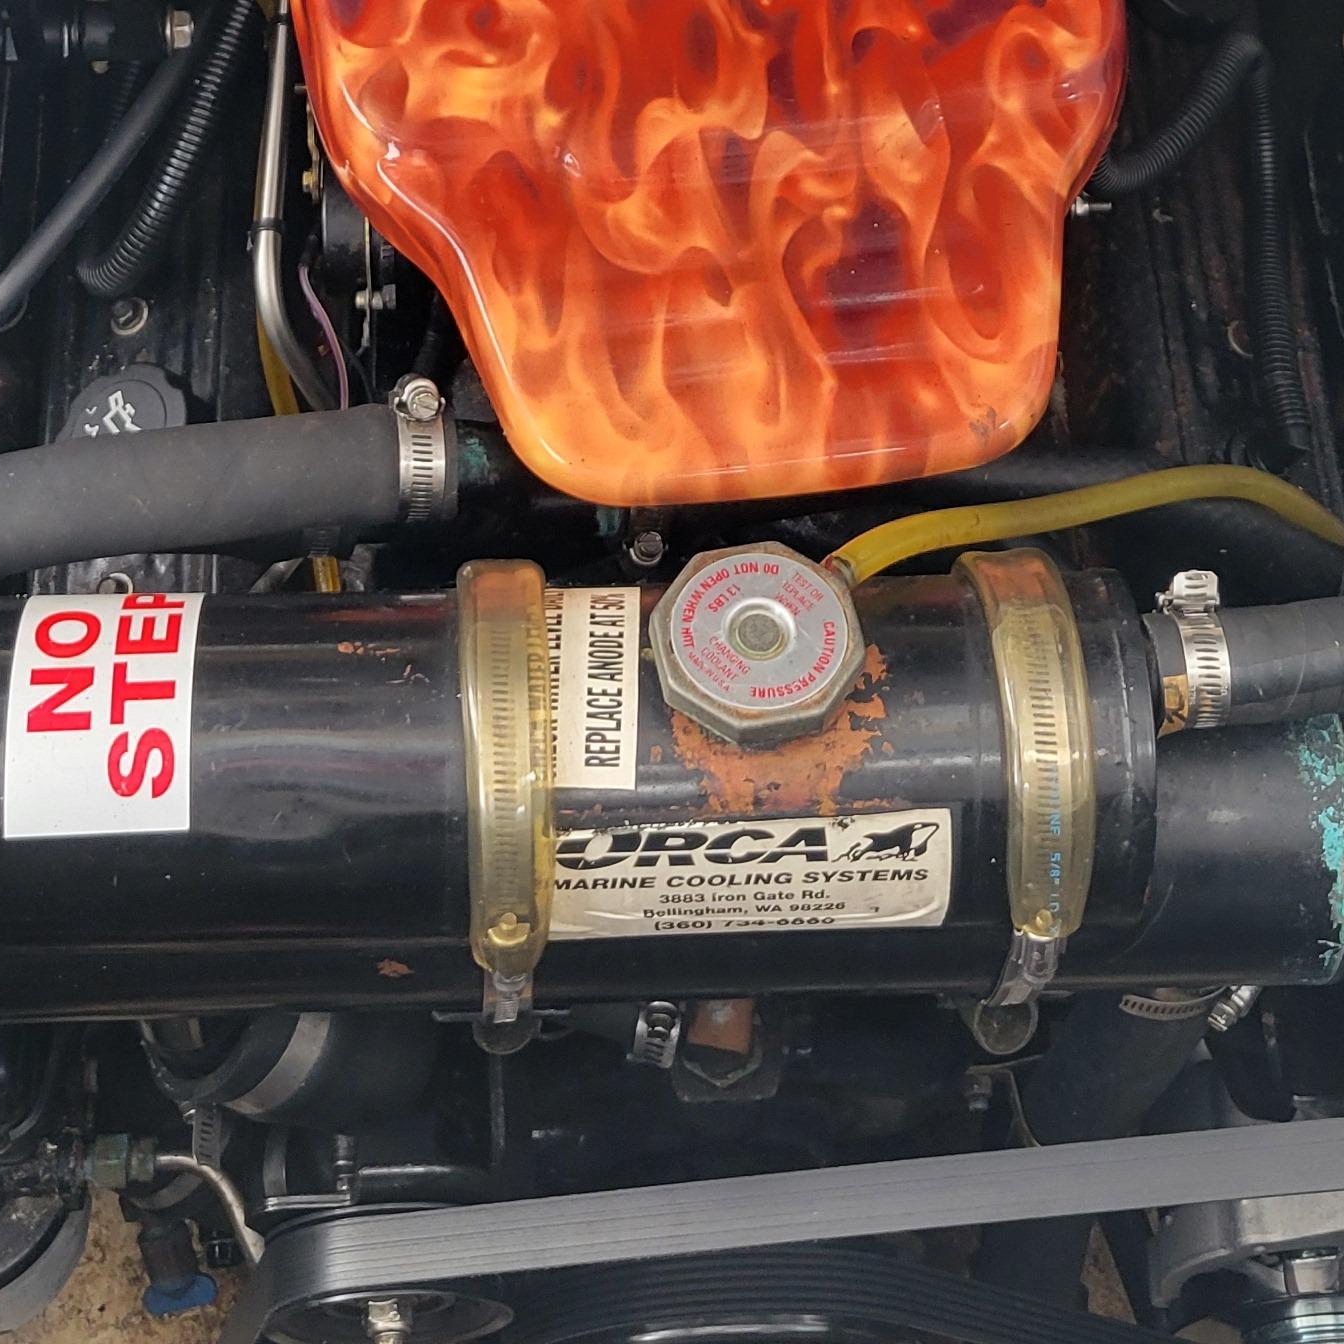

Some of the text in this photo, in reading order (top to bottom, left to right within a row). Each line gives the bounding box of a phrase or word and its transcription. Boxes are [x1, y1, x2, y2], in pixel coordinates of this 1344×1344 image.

[681, 560, 780, 649] DO NOT OPEN WHEN HOT
[708, 583, 741, 613] 13 LBS
[27, 610, 102, 733] NO
[700, 647, 739, 681] COOLANT
[708, 636, 751, 675] CHANGING
[749, 621, 835, 699] CAUTION PRESSURE
[108, 592, 185, 798] STEP
[584, 592, 626, 768] REPLACE ANODE AT 50%
[556, 826, 828, 870] ORCA
[554, 868, 929, 891] MARINE COOLING SYSTEMS
[659, 888, 831, 904] 3883 Iron Gate Rd.
[643, 901, 846, 920] Bellingham, WA 98226
[654, 918, 713, 931] (360)
